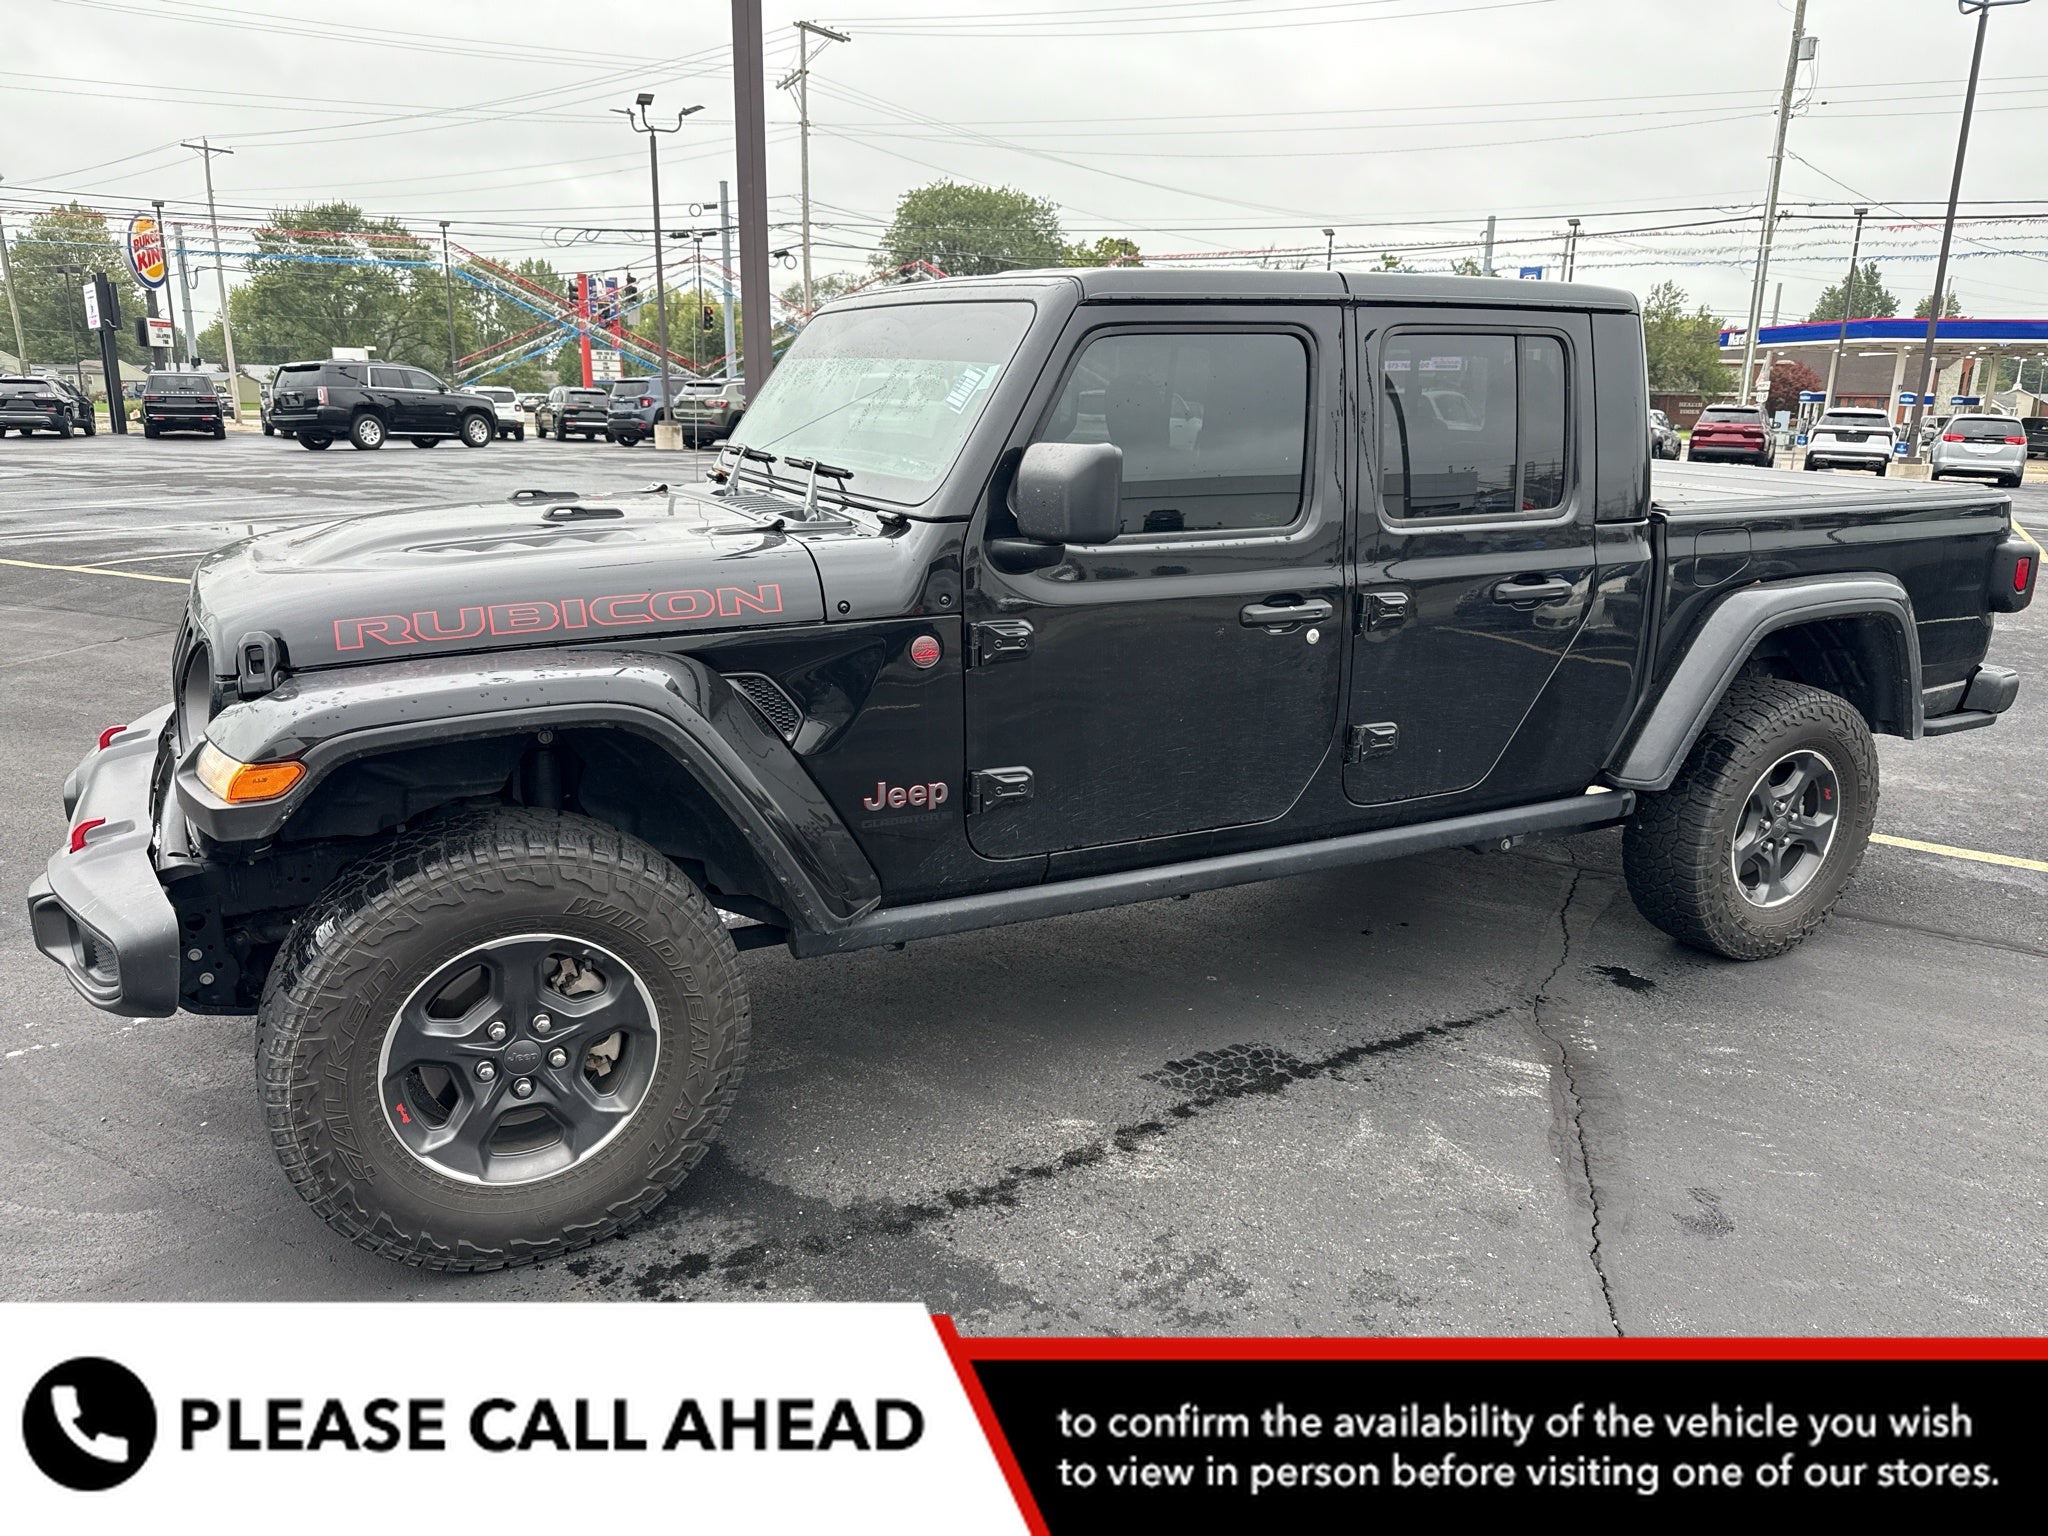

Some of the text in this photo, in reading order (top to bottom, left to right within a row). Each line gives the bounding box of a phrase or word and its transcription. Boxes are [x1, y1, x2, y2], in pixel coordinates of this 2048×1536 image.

[133, 231, 160, 252] BURGE
[137, 245, 164, 272] KIN
[333, 584, 783, 651] RUBICON
[863, 781, 949, 811] Jeep
[563, 896, 712, 1088] WILDPEAK
